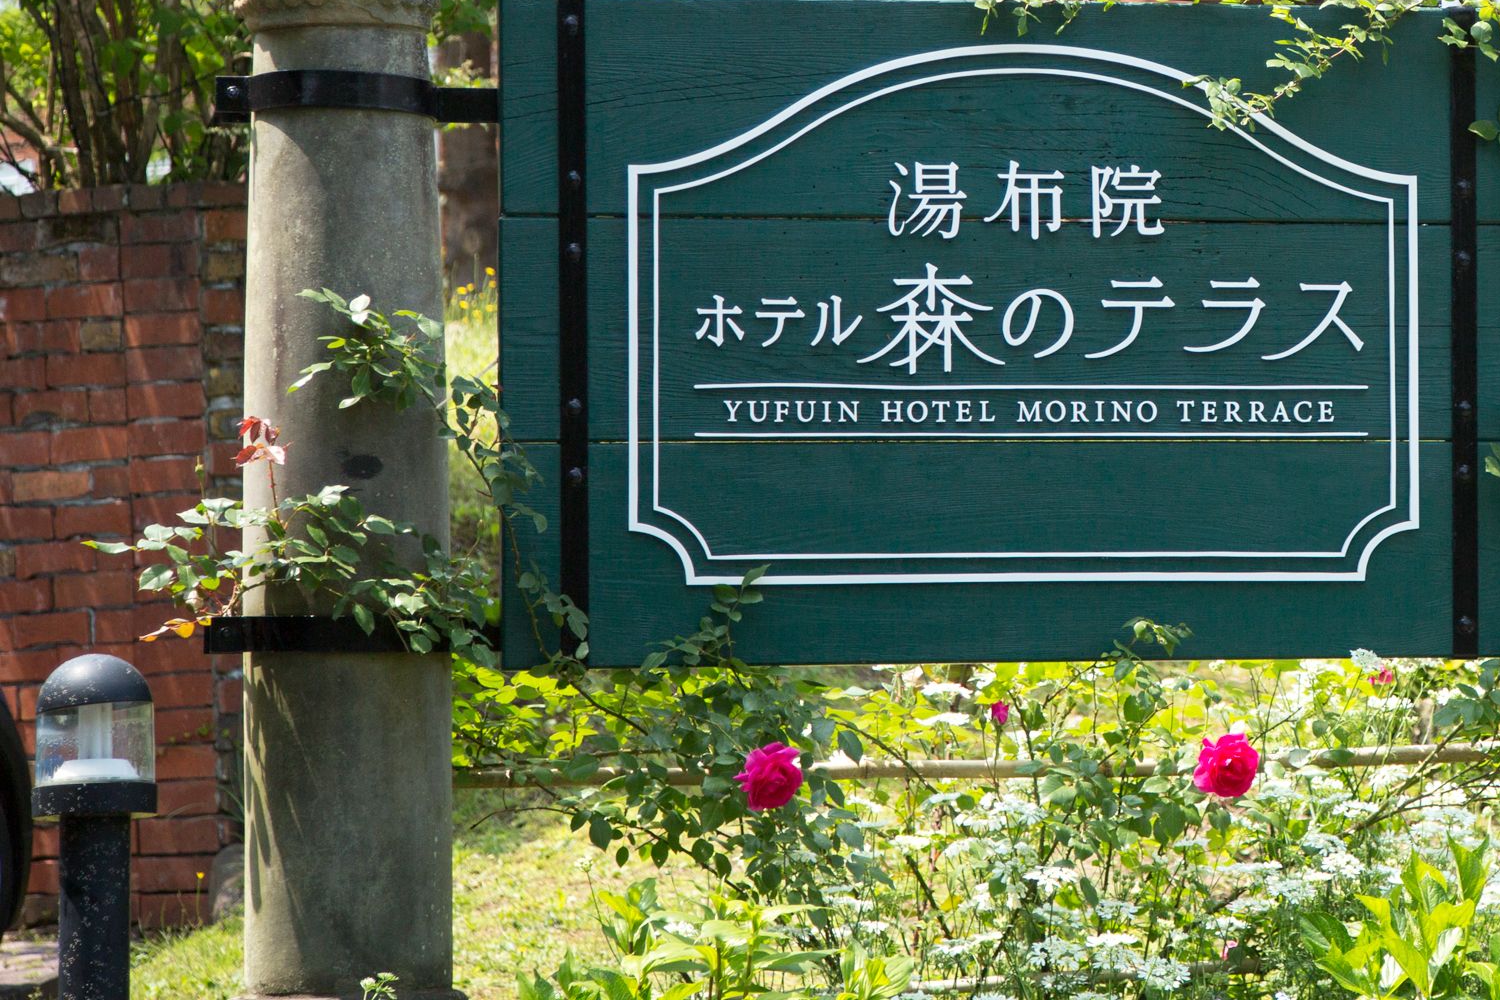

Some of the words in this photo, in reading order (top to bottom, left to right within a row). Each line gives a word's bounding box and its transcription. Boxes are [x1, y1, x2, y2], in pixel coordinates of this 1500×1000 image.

[887, 159, 1166, 241] 湯布院
[723, 399, 861, 424] YUFUIN
[880, 399, 997, 424] HOTEL
[1015, 399, 1159, 424] MORINO
[1176, 399, 1336, 424] TERRACE
